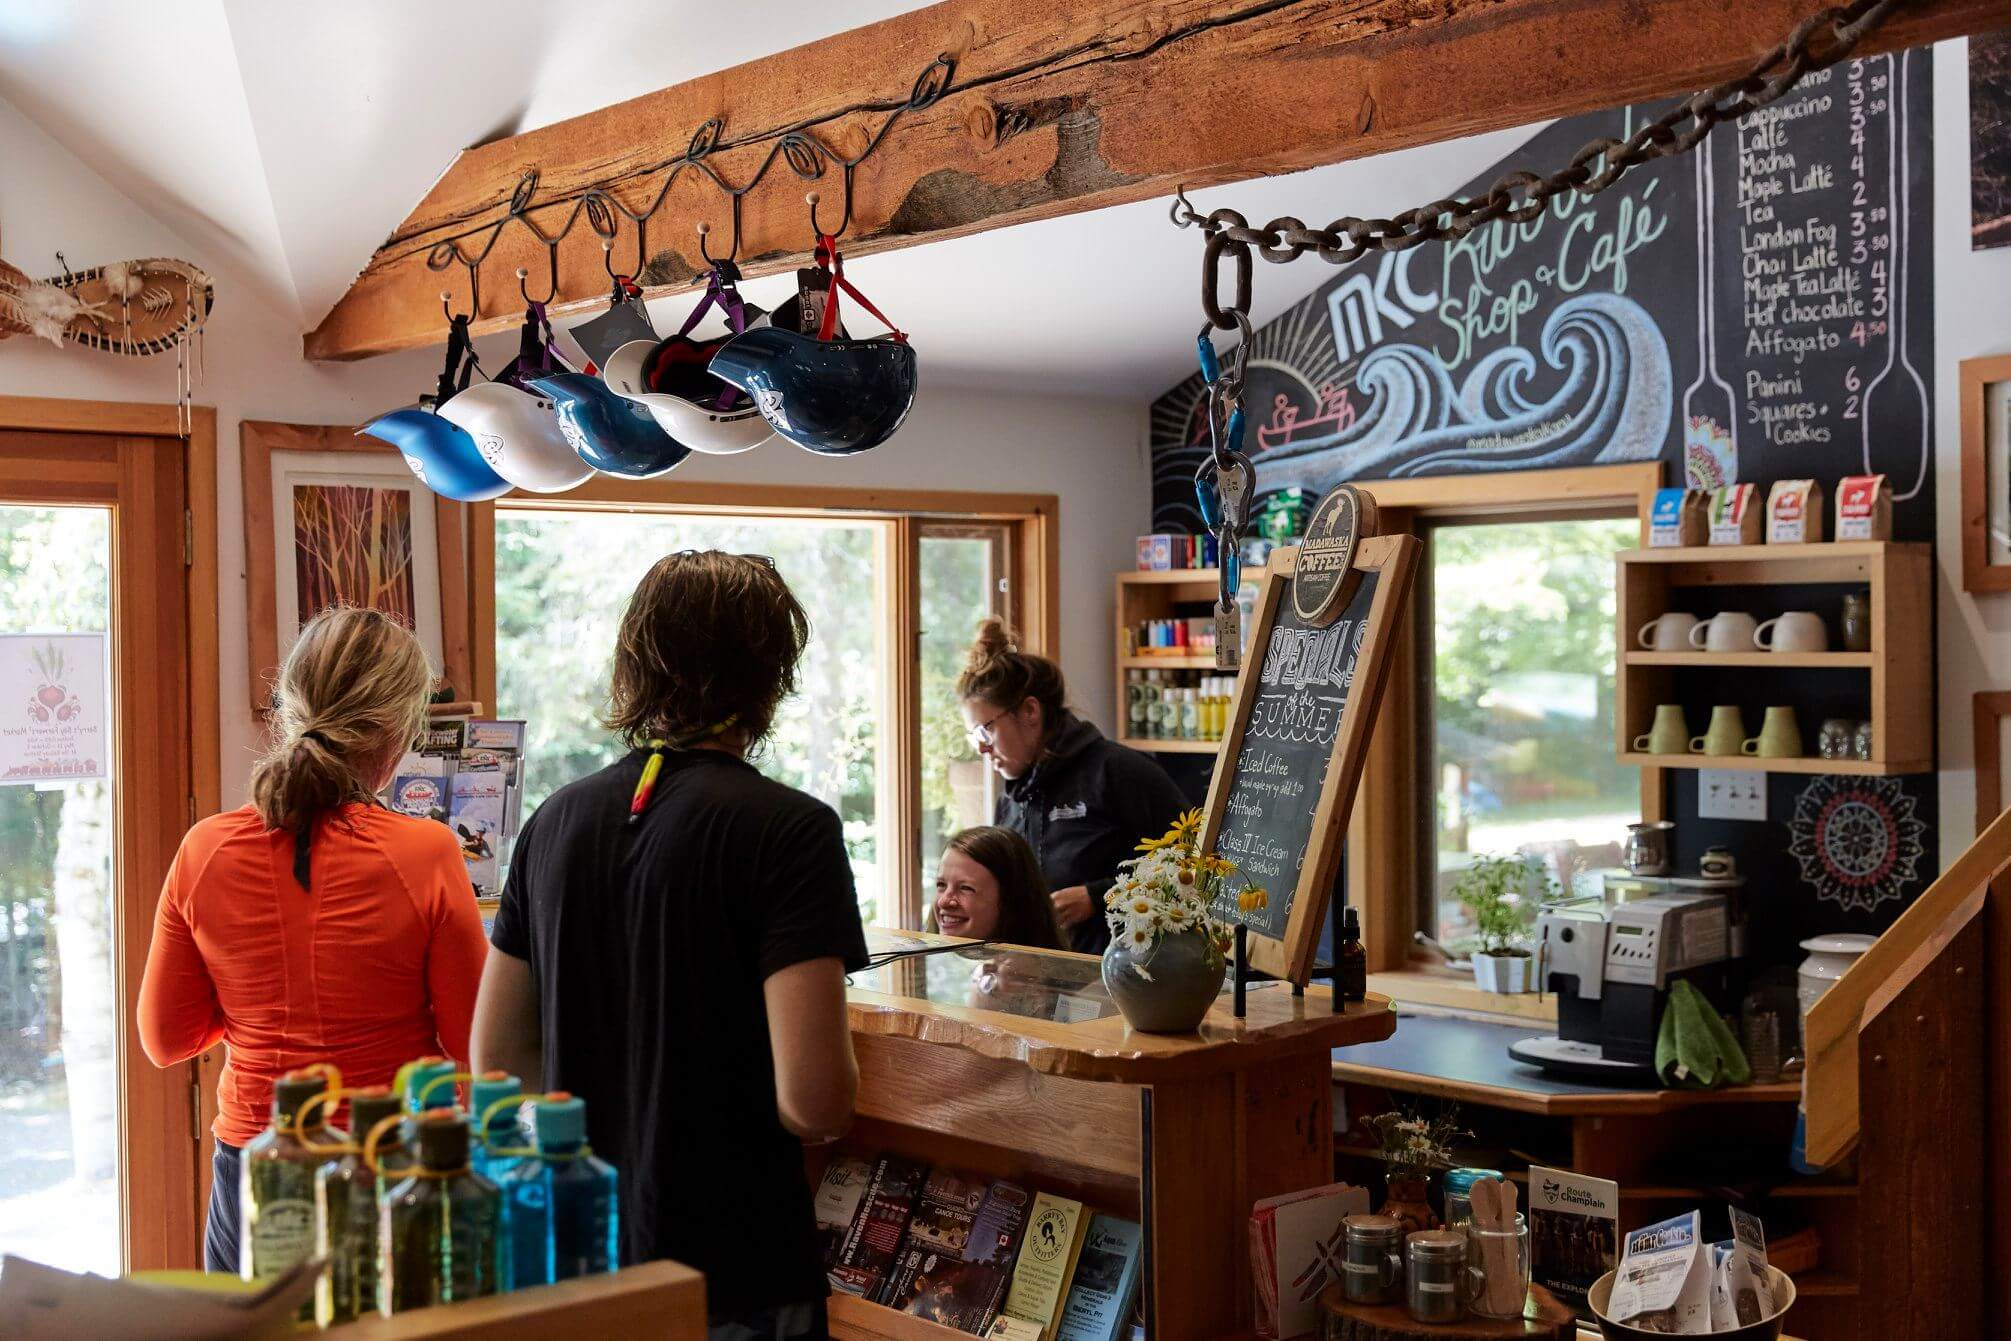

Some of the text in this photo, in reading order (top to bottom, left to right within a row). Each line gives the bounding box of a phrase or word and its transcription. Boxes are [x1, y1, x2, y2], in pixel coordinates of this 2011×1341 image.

[1739, 130, 1866, 178] Mocha 4
[1738, 175, 1784, 203] Maple
[1850, 155, 1865, 178] 4
[1737, 181, 1868, 226] Tea 2
[1741, 207, 1887, 254] London Fog 3.50
[1434, 278, 1539, 370] Shop
[1558, 177, 1668, 295] Café
[1743, 252, 1786, 279] Chai
[1850, 234, 1889, 264] 3.50
[1744, 275, 1790, 302] Maple
[1790, 271, 1819, 296] Tea
[1870, 259, 1888, 286] 4
[1327, 246, 1439, 364] MKC
[1744, 287, 1888, 327] Hot chocolate 3
[1745, 320, 1887, 364] Affogato 4.50
[1746, 365, 1862, 400] Panini 6
[1746, 394, 1859, 440] Squares 2
[1773, 421, 1832, 446] Cookies
[1286, 690, 1315, 710] of the
[1241, 748, 1289, 776] Iced Coffee
[1230, 791, 1263, 828] Affogato
[1222, 828, 1242, 851] Class
[1265, 839, 1289, 859] Cream
[1248, 856, 1280, 877] Sandwich
[1560, 1192, 1605, 1209] Champlain
[1566, 1186, 1592, 1199] Route
[934, 1207, 972, 1223] CANOE TOURS
[1036, 1210, 1060, 1229] BARRY'S
[1546, 1279, 1561, 1289] THE
